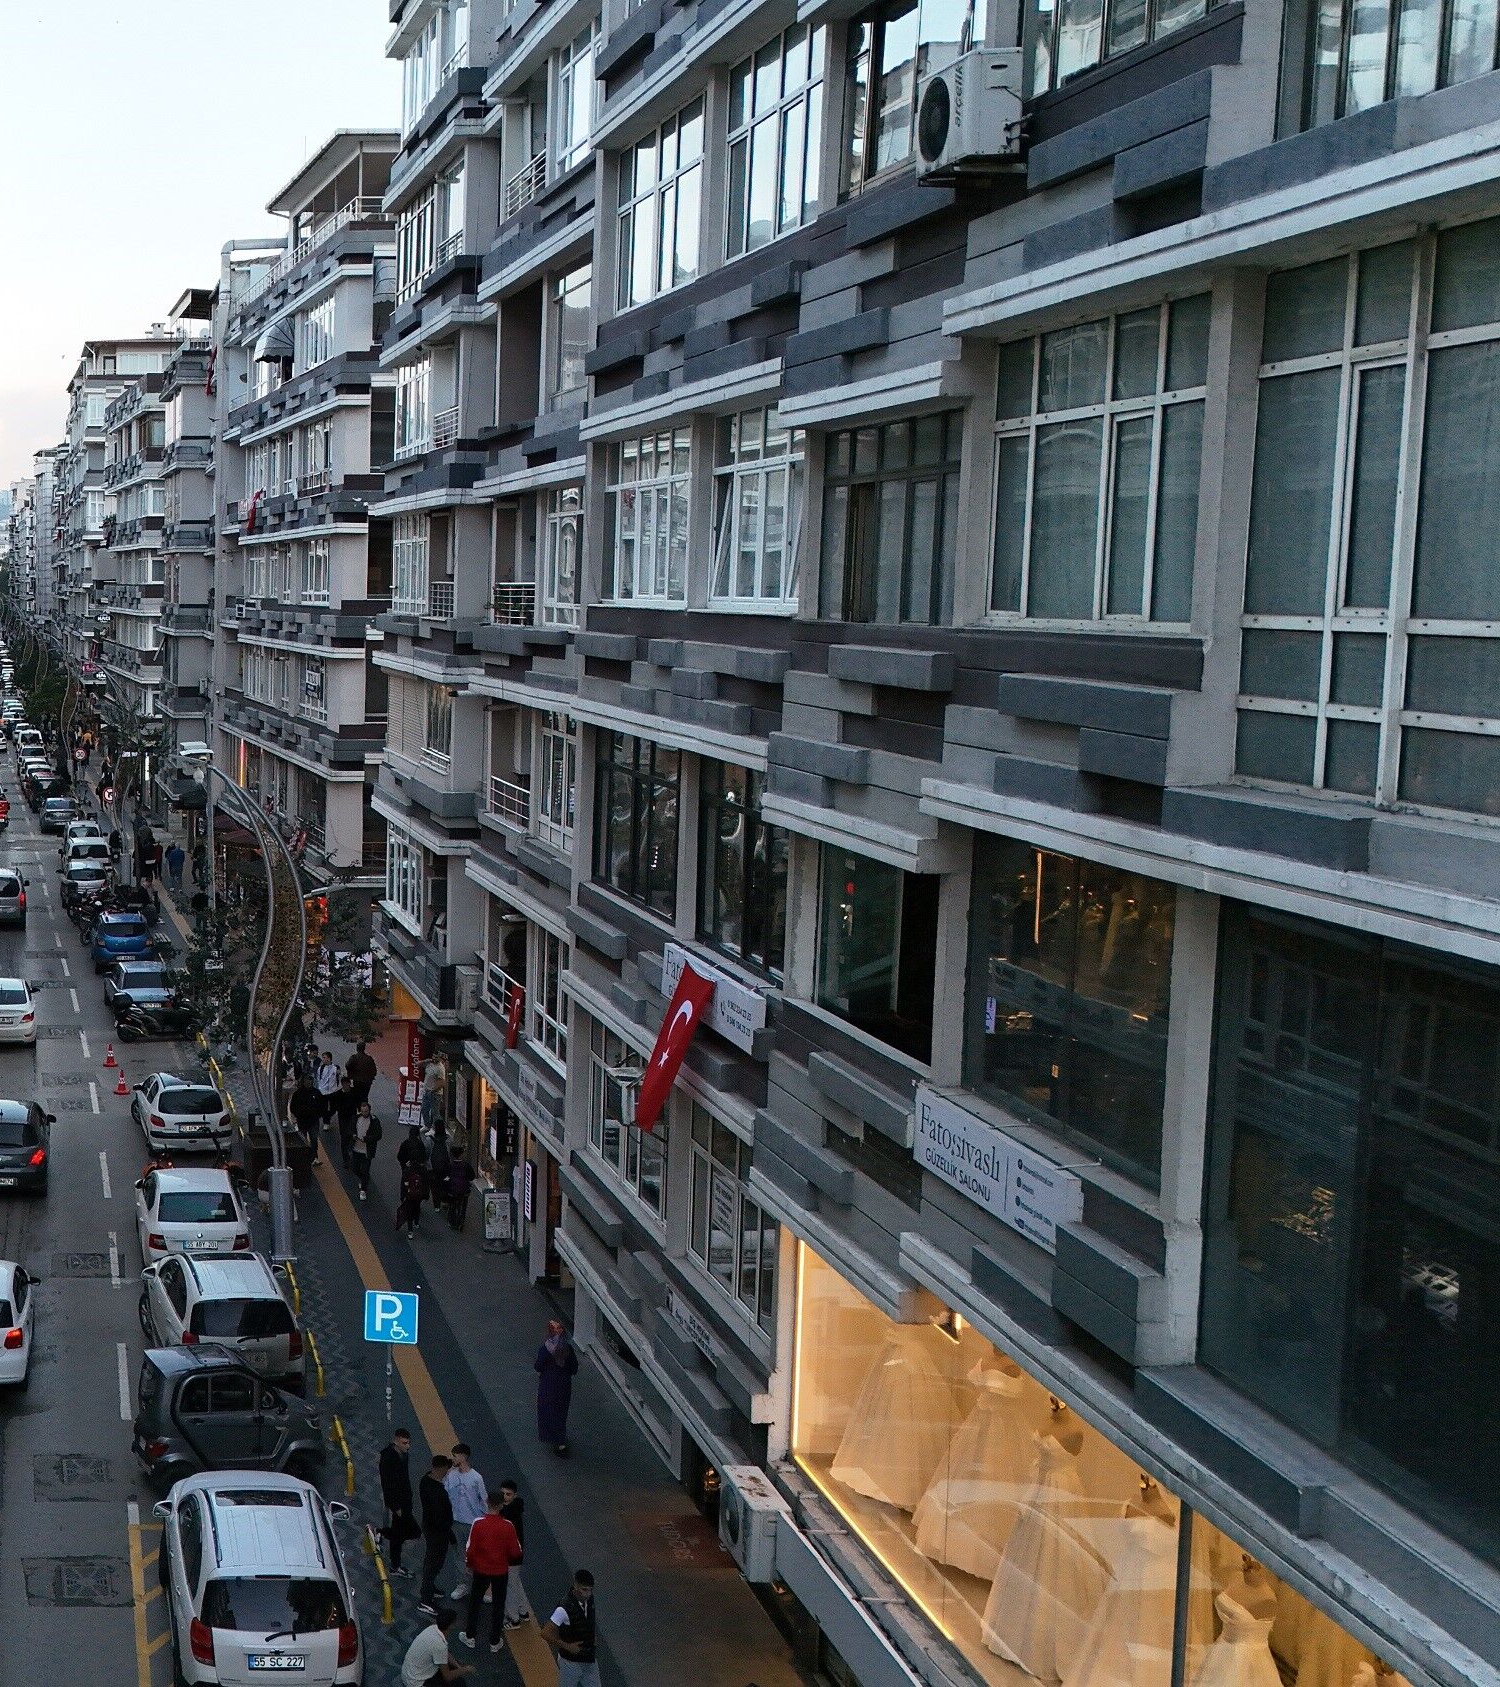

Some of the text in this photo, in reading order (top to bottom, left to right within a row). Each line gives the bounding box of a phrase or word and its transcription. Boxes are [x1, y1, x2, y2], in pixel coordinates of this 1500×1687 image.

[925, 1147, 958, 1182] GÜZELLİK
[959, 1169, 991, 1202] SALONU
[375, 1293, 403, 1332] P
[254, 1657, 303, 1667] 55 SC 227
